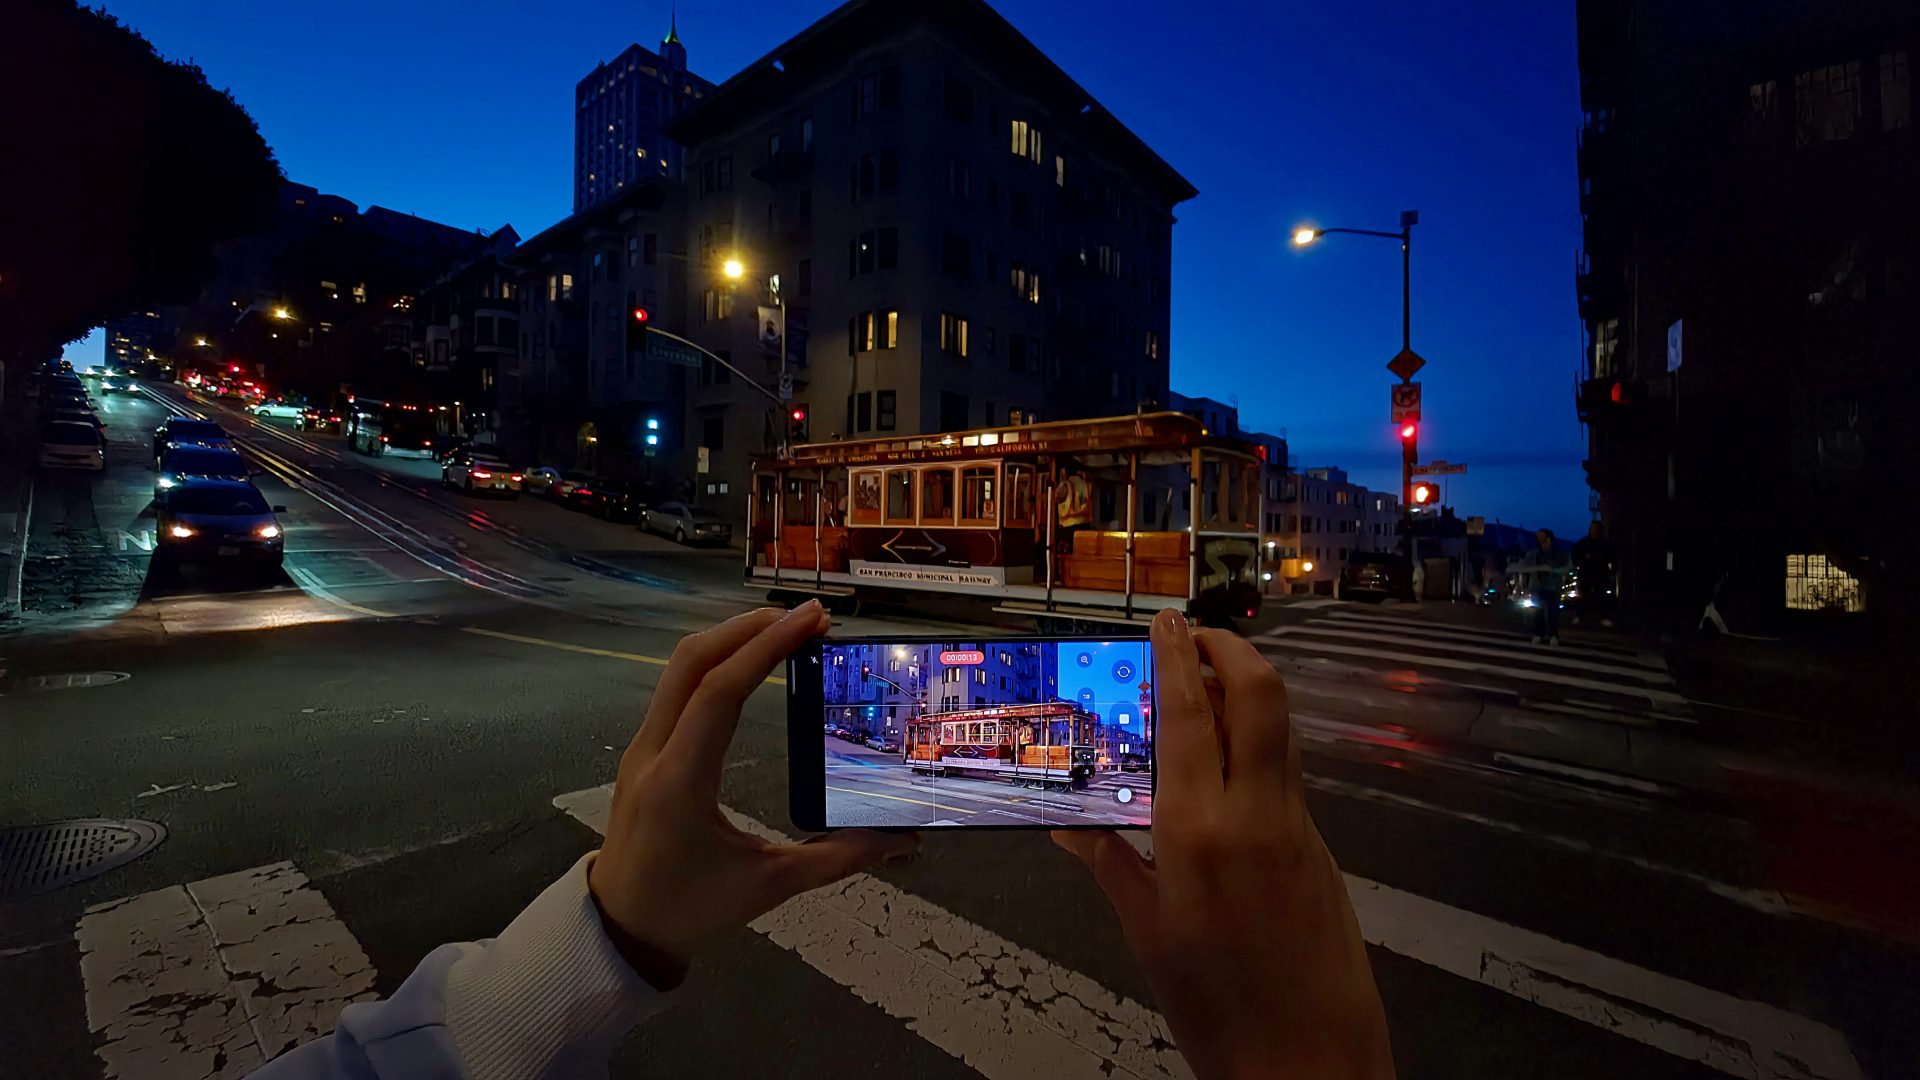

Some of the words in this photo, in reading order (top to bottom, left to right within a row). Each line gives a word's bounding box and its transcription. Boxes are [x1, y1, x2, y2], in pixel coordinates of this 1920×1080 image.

[990, 442, 1037, 454] CALIFORNIA
[859, 568, 873, 576] SAN
[874, 570, 912, 579] FRANCISCO
[916, 573, 954, 582] MUNICIPAL
[957, 575, 991, 585] RAILWAY
